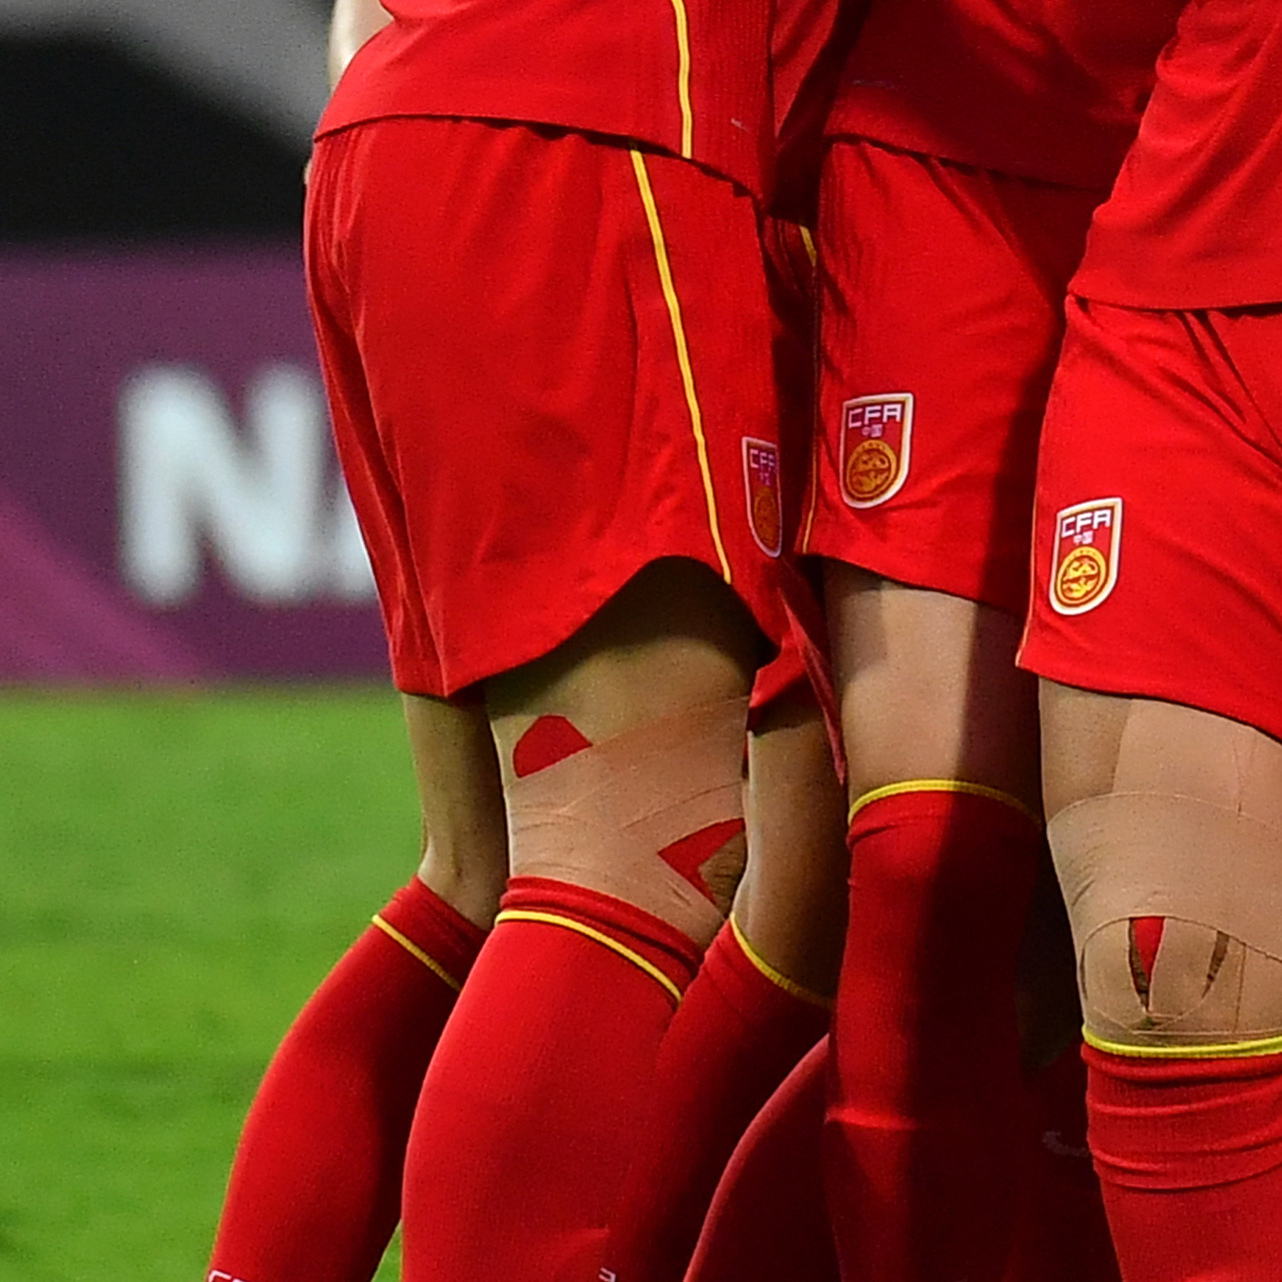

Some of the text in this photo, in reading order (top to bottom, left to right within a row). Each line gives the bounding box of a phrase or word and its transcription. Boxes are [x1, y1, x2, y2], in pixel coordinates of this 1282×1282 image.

[848, 404, 902, 428] CFA
[117, 363, 379, 608] N
[1061, 509, 1111, 538] CFA
